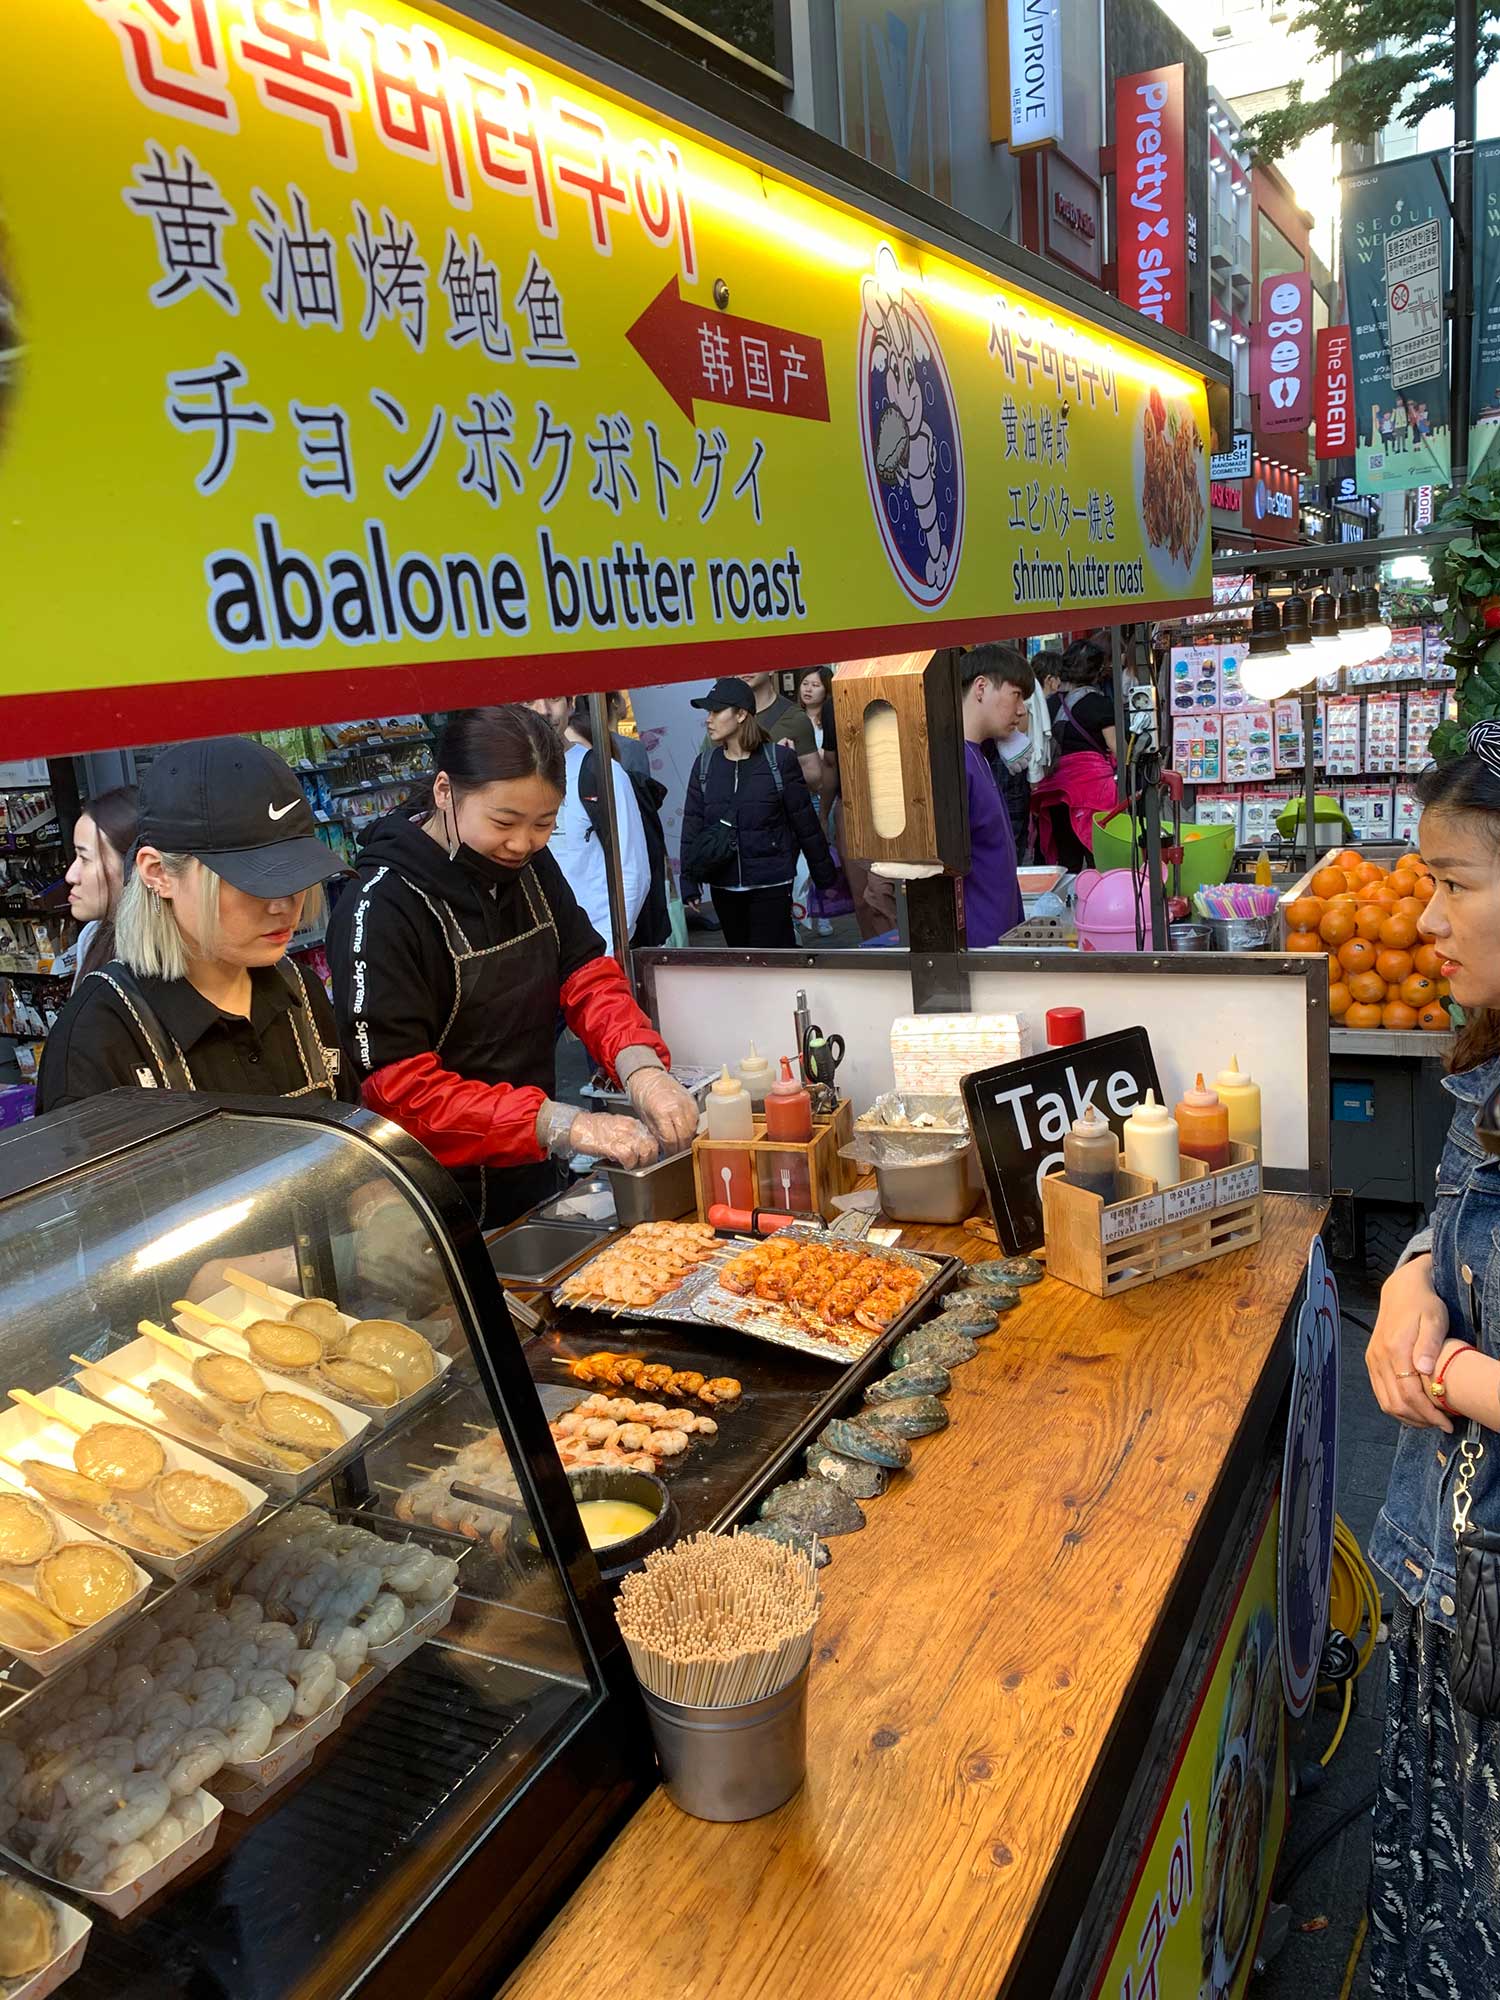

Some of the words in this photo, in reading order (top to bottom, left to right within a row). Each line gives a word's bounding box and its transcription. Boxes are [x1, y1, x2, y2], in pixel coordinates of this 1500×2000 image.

[1131, 81, 1169, 213] Pretty
[130, 148, 577, 366] 黄油烤鲍鱼
[697, 321, 810, 405] 韩国产
[1327, 337, 1347, 370] the
[171, 357, 766, 523] チョンボクボトグイ
[1326, 373, 1347, 447] SAEM
[1008, 482, 1116, 541] エビバター焼き
[211, 522, 529, 646] abalone
[539, 531, 695, 629] butter
[708, 548, 806, 619] roast
[1013, 547, 1065, 607] shrimp
[1068, 549, 1111, 597] butter
[1114, 557, 1144, 595] roast
[353, 899, 371, 954] Supreme
[353, 960, 367, 1014] Supreme
[994, 1066, 1140, 1151] Take
[1141, 1199, 1156, 1211] 소스
[1198, 1181, 1213, 1193] 소스
[1104, 1224, 1138, 1241] teriyaki
[1139, 1216, 1164, 1231] sauce
